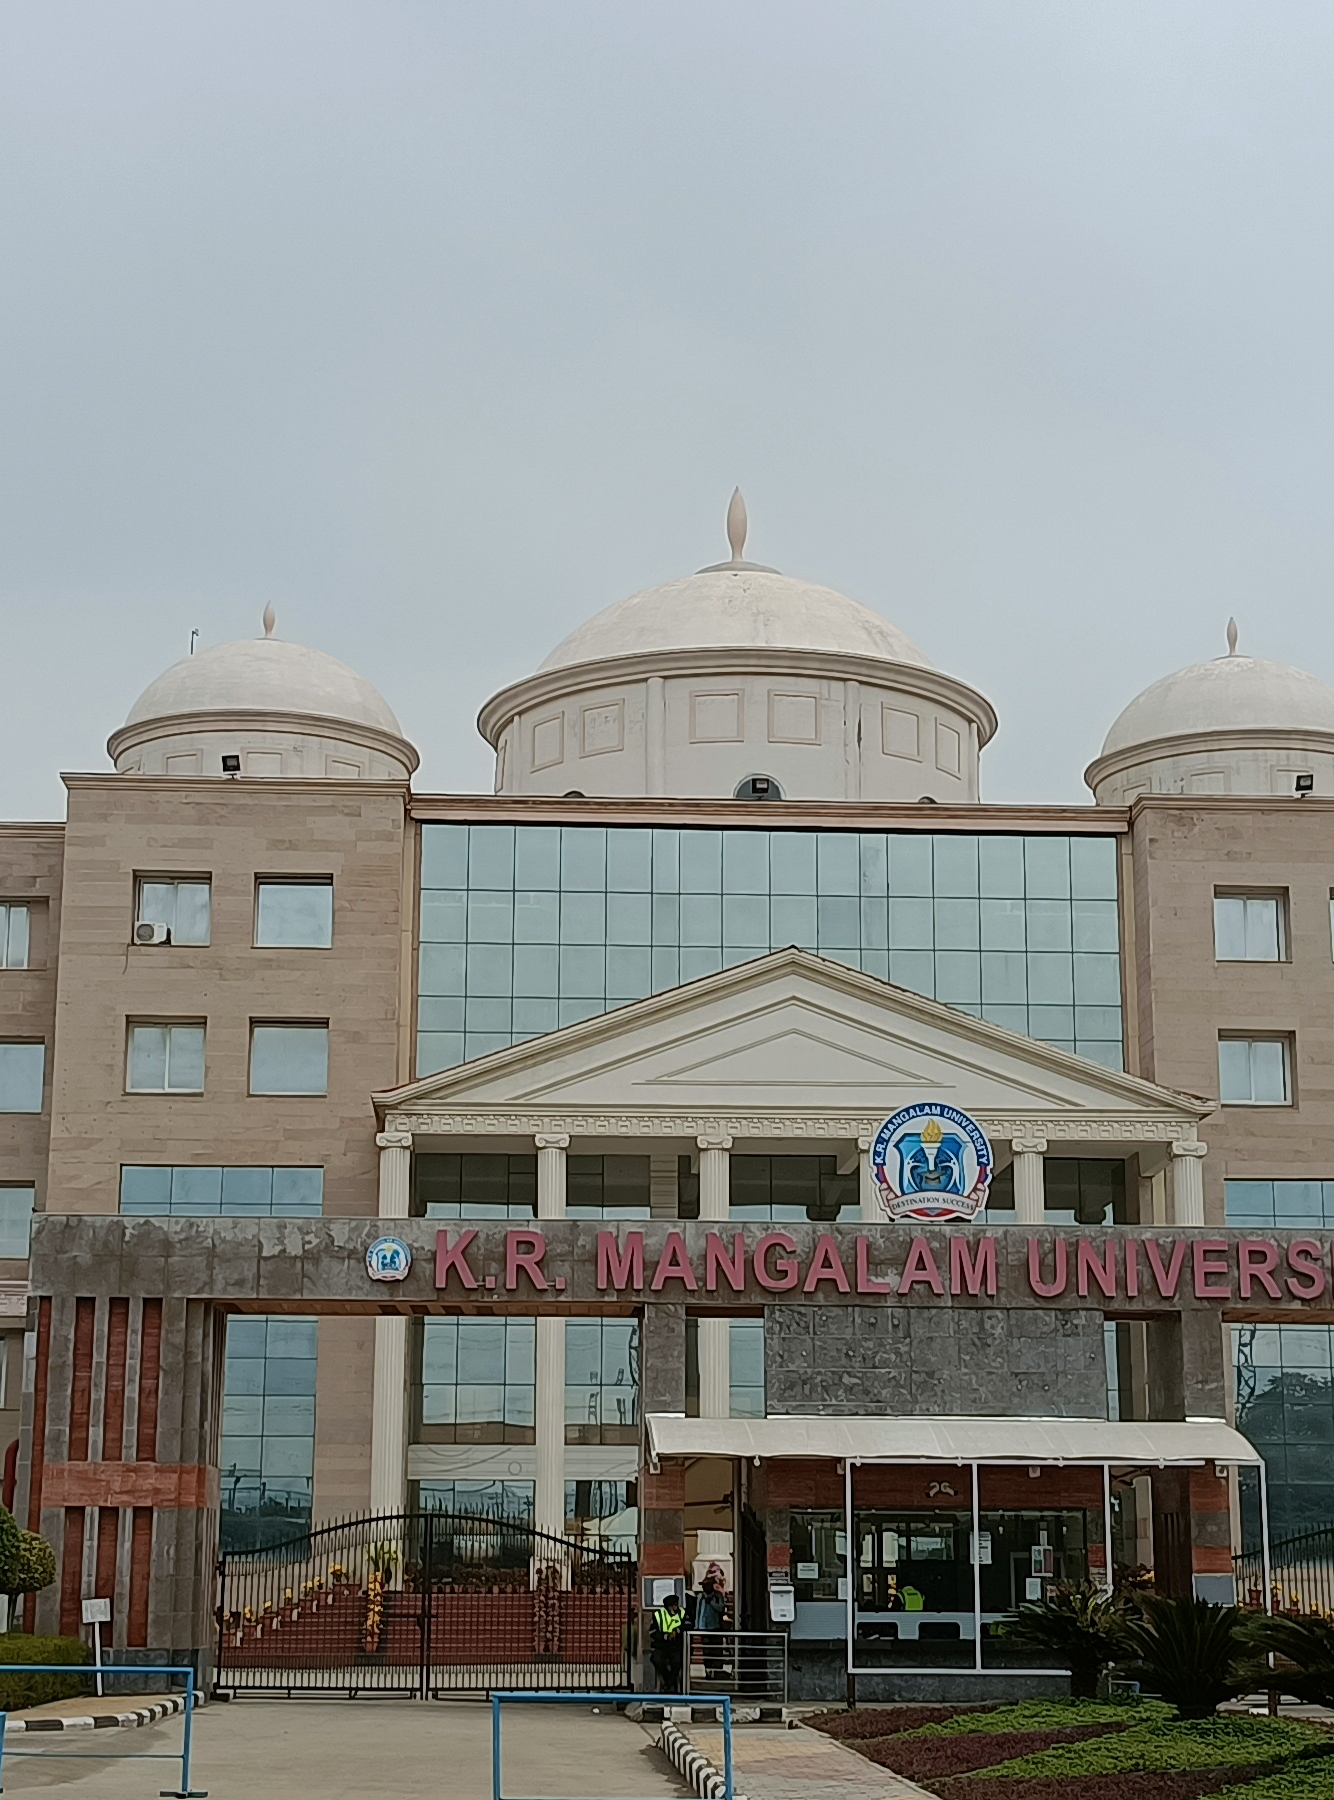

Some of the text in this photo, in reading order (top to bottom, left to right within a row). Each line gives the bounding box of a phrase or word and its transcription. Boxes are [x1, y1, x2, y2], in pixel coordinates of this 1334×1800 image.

[874, 1105, 989, 1165] K.R. MANGALAM UNIVERSITY
[891, 1196, 974, 1211] DESTINATION SUCCESS
[435, 1229, 566, 1290] K.R.
[596, 1230, 998, 1297] MANGALAM
